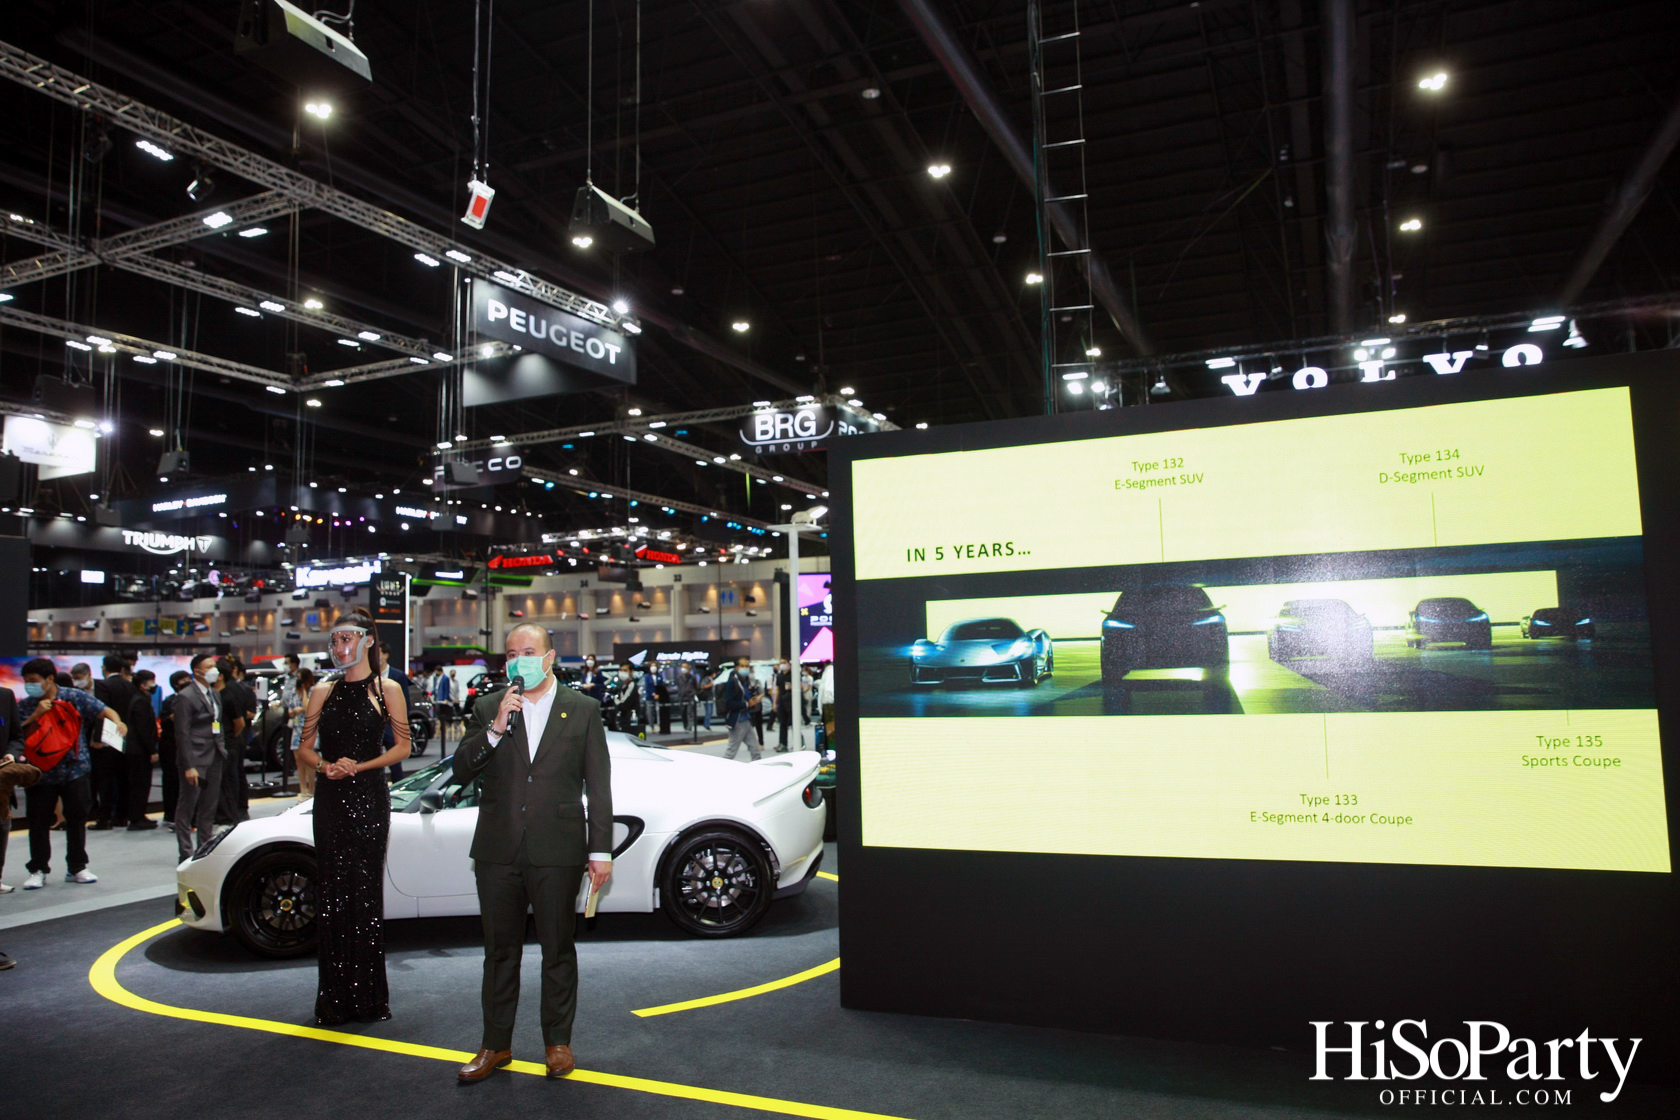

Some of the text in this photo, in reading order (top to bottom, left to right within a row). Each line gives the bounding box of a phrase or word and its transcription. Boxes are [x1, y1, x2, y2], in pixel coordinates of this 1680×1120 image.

[487, 298, 621, 364] PEUGEOT
[1221, 344, 1543, 397] VOLVO
[755, 410, 816, 441] BRG
[755, 441, 818, 455] GROUP
[1131, 457, 1184, 473] Type 132
[1399, 449, 1460, 465] Type 134
[1114, 472, 1204, 490] E-Segment SUV
[1379, 465, 1485, 484] D-Segment SUV
[122, 530, 196, 551] TRIUMPH
[502, 555, 553, 568] HONDA
[646, 550, 681, 564] HONDA
[906, 548, 925, 562] IN
[935, 546, 944, 560] 5
[1535, 735, 1603, 749] Type 135
[1522, 755, 1621, 769] Sports Coupe
[1300, 794, 1358, 807] Type 133
[1250, 811, 1413, 827] E-Segment 4-door Coupe
